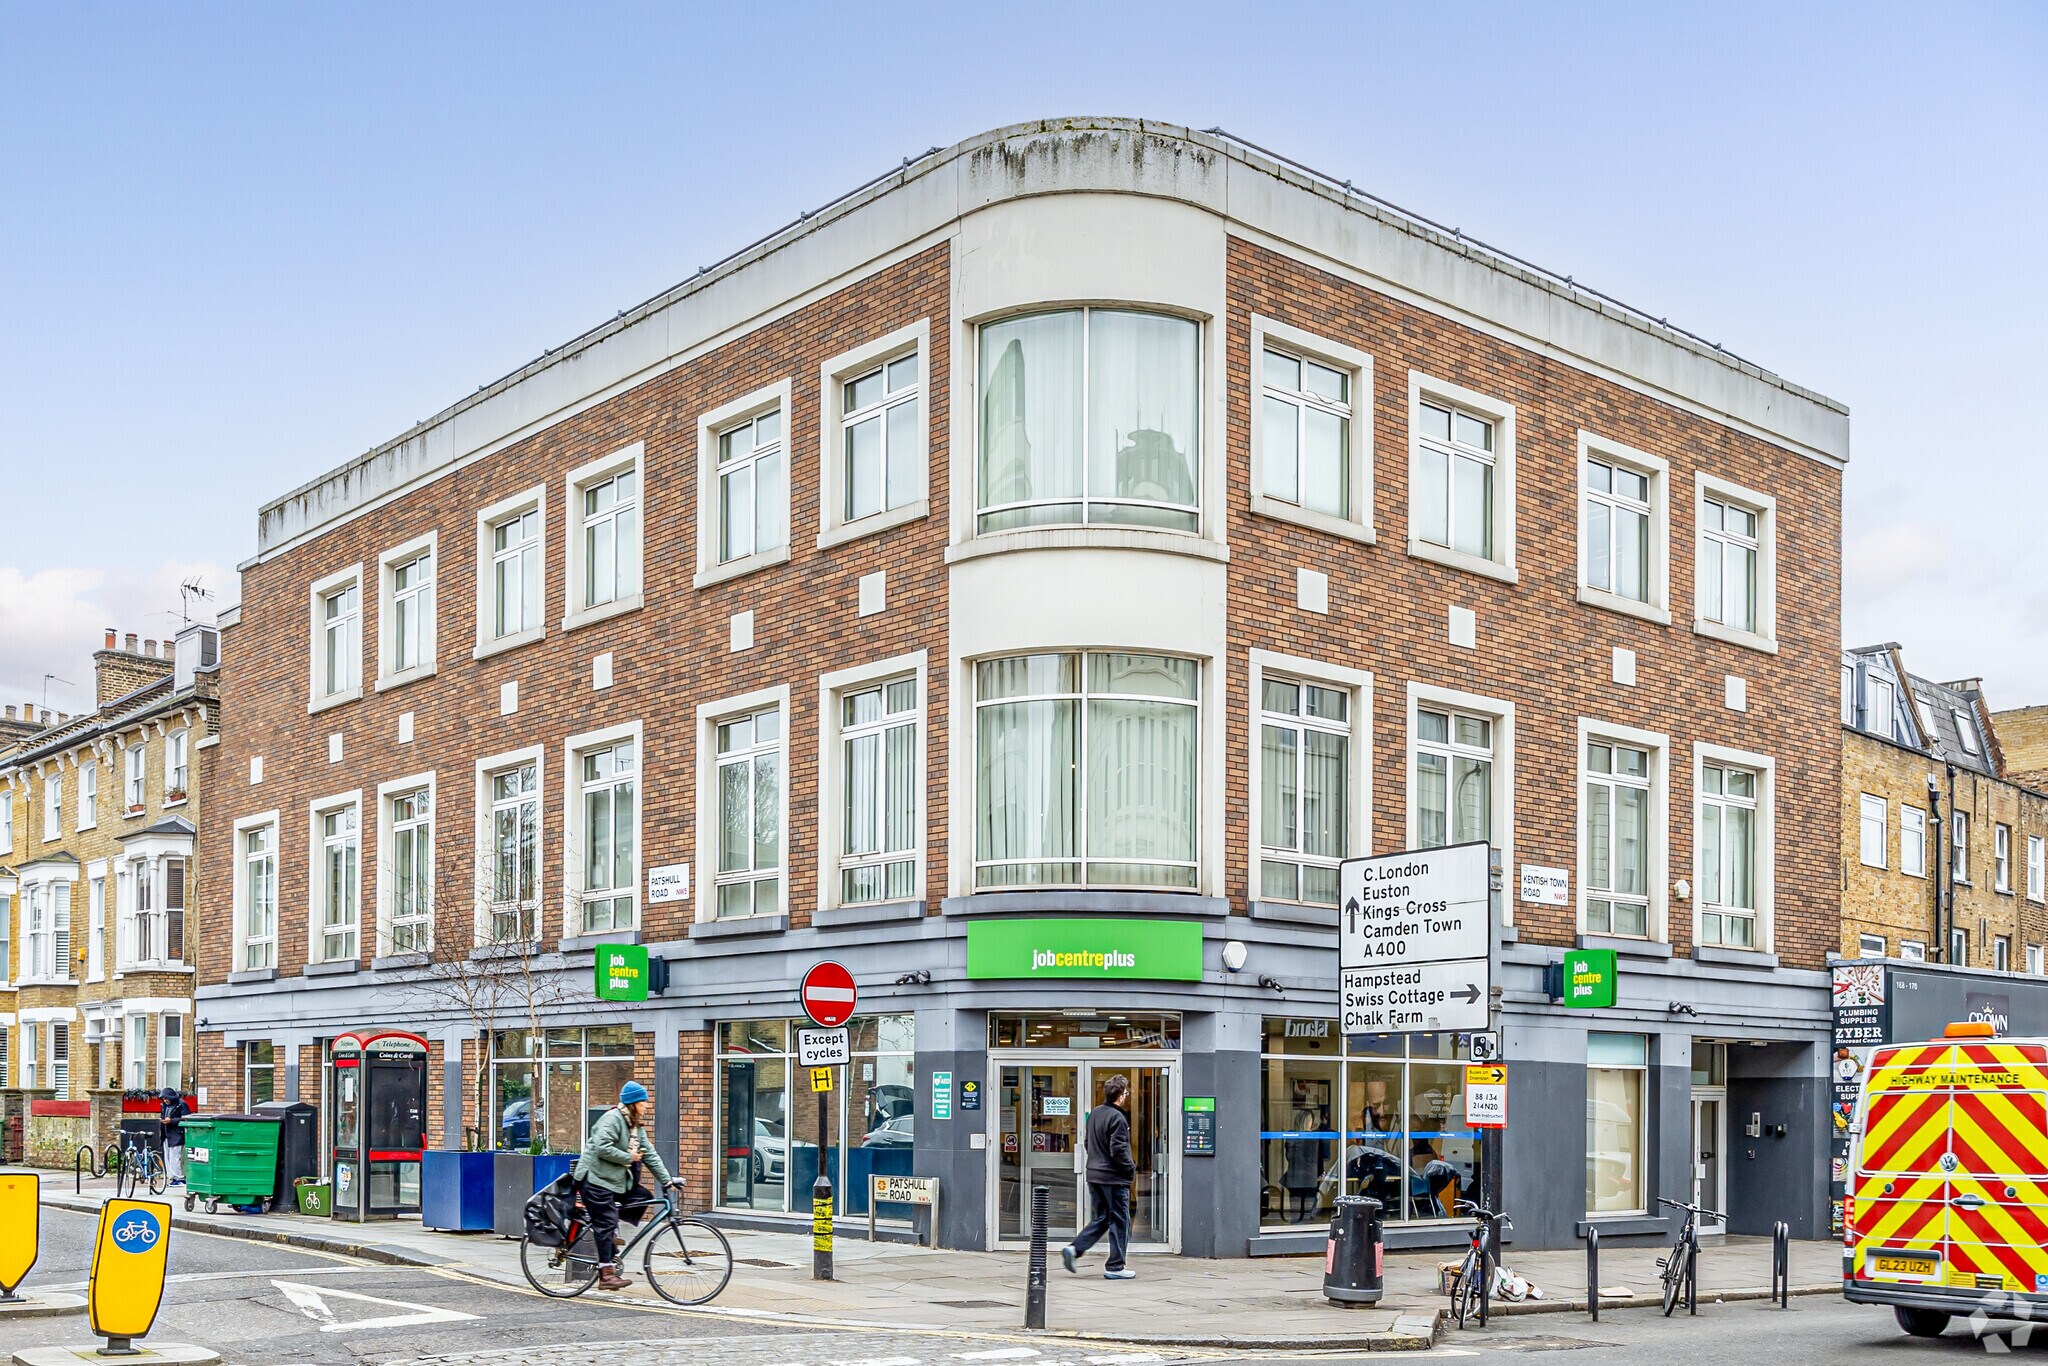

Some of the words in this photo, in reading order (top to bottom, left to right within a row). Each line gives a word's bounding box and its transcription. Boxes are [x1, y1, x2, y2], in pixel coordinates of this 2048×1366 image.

[1363, 862, 1429, 881] C.London
[651, 875, 681, 886] PATSHULL
[1523, 875, 1548, 886] KENTISH
[1550, 877, 1567, 888] TOWN
[651, 888, 669, 899] ROAD
[676, 887, 687, 896] NW5
[1363, 884, 1410, 901] Euston
[1523, 887, 1541, 898] ROAD
[1554, 893, 1566, 901] NW5
[1363, 905, 1400, 921] Kings
[1406, 900, 1447, 915] Cross
[1363, 922, 1419, 939] Camden
[1424, 918, 1462, 934] Town
[609, 953, 625, 968] job
[1032, 949, 1135, 971] jobcentreplus
[609, 966, 639, 978] centre
[1573, 960, 1588, 975] job
[609, 976, 629, 990] plus
[1344, 969, 1421, 990] Hampstead
[1573, 972, 1602, 985] centre
[1345, 992, 1384, 1007] Swiss
[1388, 989, 1445, 1005] Cottage
[1573, 984, 1593, 999] plus
[1345, 1010, 1384, 1027] Chalk
[1388, 1009, 1423, 1024] Farm
[1839, 1008, 1879, 1017] PLUMBING
[1840, 1016, 1877, 1025] SUPPLIES
[1969, 1012, 2008, 1031] CROWN
[804, 1034, 844, 1046] Except
[1835, 1027, 1883, 1039] ZYBER
[382, 1040, 411, 1049] Telephone
[806, 1047, 843, 1061] cycles
[1891, 1075, 1937, 1085] HIGHWAY
[1941, 1074, 2019, 1083] MAINTENANCE
[889, 1178, 927, 1191] PATSHULL
[889, 1190, 912, 1201] ROAD
[1879, 1259, 1907, 1271] GL23
[1909, 1262, 1931, 1273] UZH
